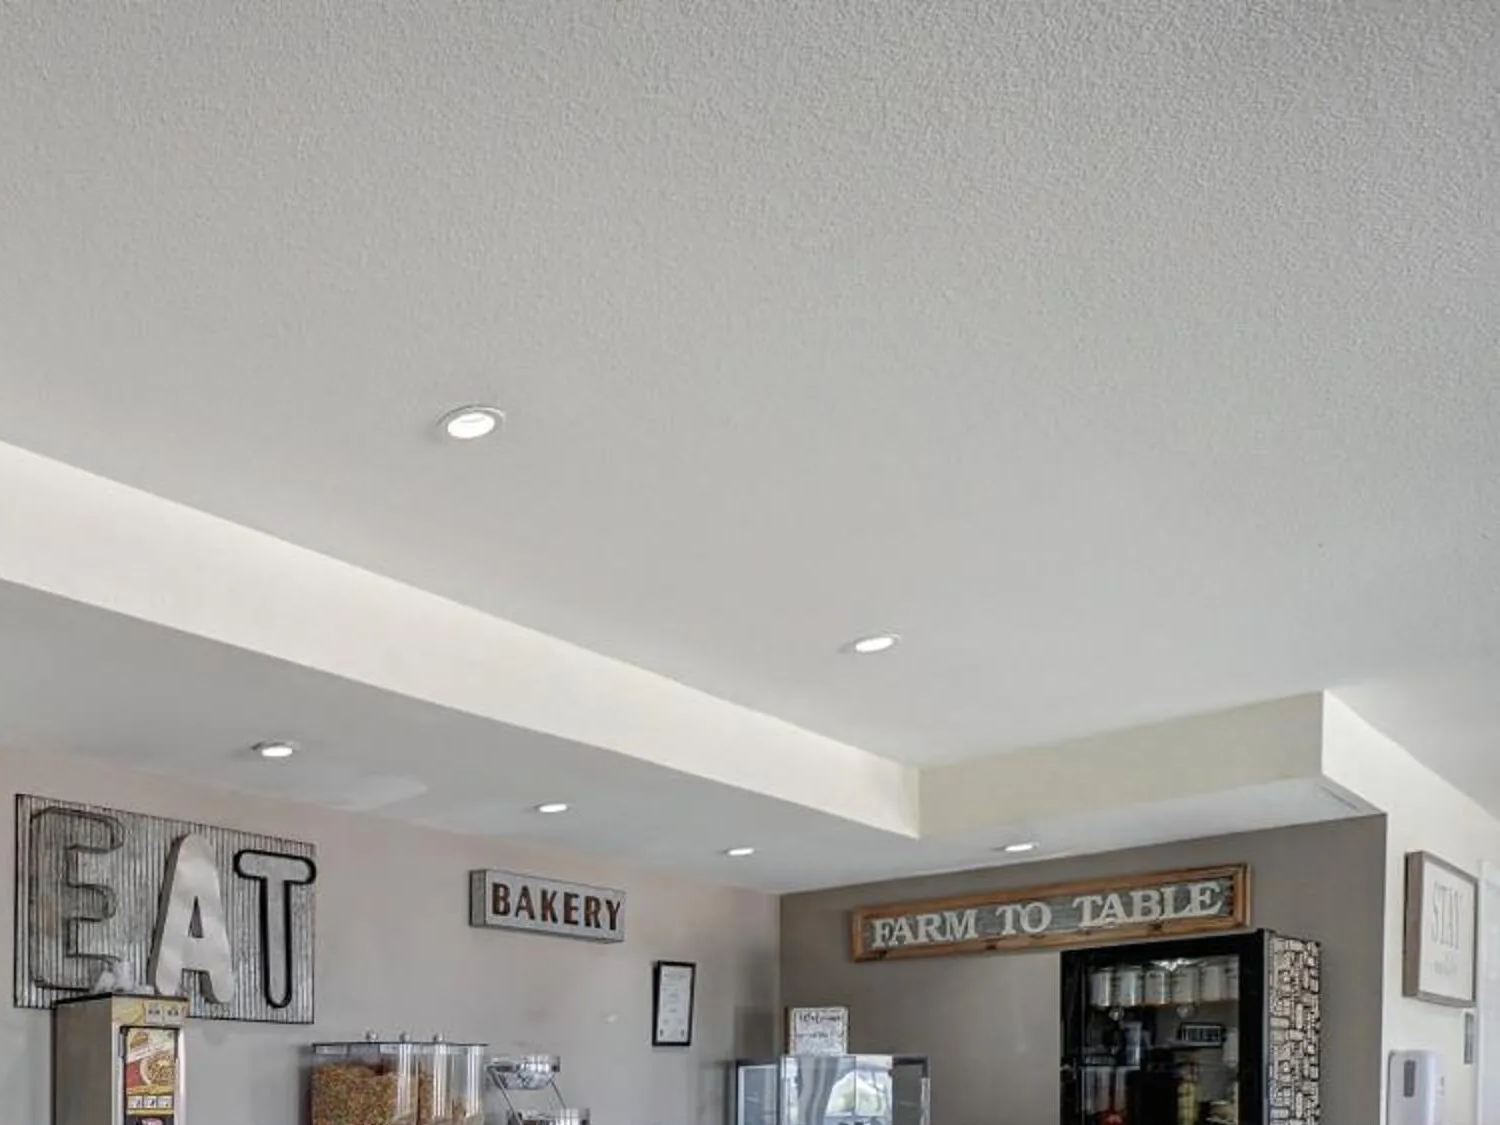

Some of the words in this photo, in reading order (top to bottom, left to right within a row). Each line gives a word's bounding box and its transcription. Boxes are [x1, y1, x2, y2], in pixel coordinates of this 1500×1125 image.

[28, 806, 317, 1009] EAT
[491, 882, 621, 931] BAKERY
[872, 909, 980, 949] FARM
[995, 901, 1052, 936] TO
[1072, 880, 1223, 930] TABLE
